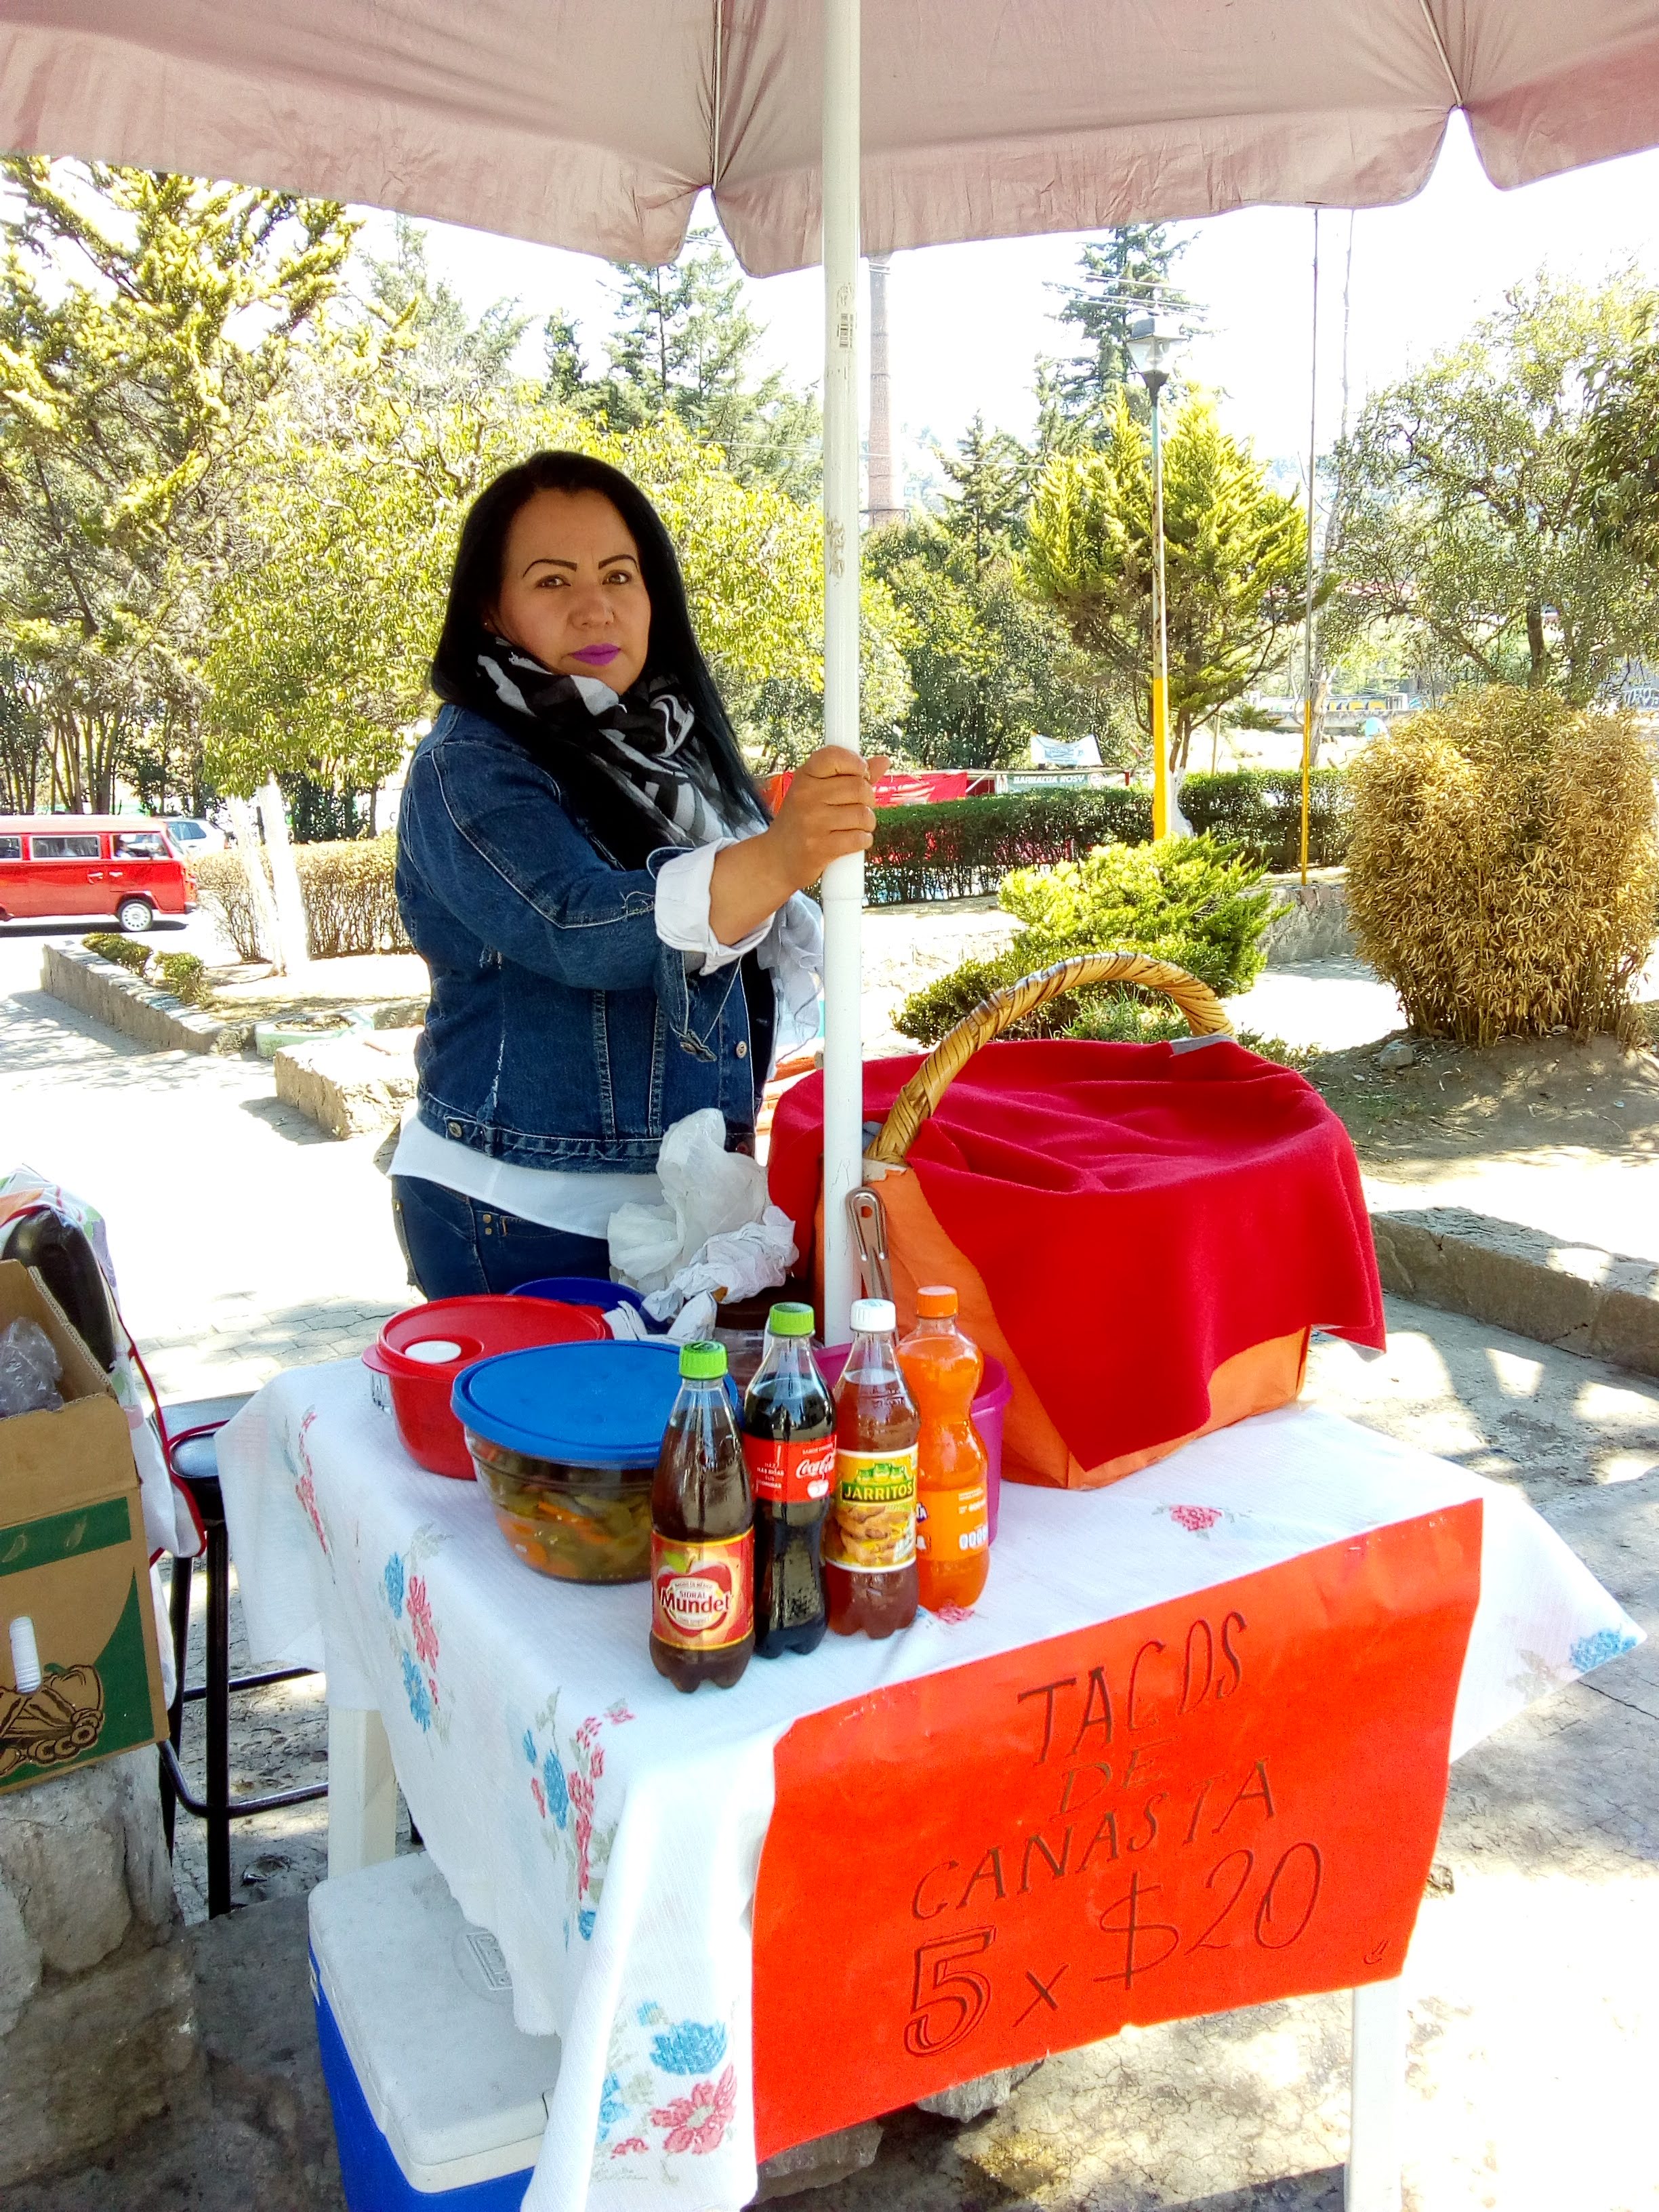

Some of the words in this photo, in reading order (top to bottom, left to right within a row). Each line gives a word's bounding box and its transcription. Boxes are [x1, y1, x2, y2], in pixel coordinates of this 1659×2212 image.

[1059, 775, 1085, 783] ROSY
[845, 1481, 912, 1500] JARRITOS
[660, 1587, 731, 1614] Mundet
[1017, 1611, 1246, 1766] TACOS
[1049, 1737, 1181, 1822] DE
[912, 1757, 1275, 1919] CANASTA
[903, 1925, 997, 2056] 5
